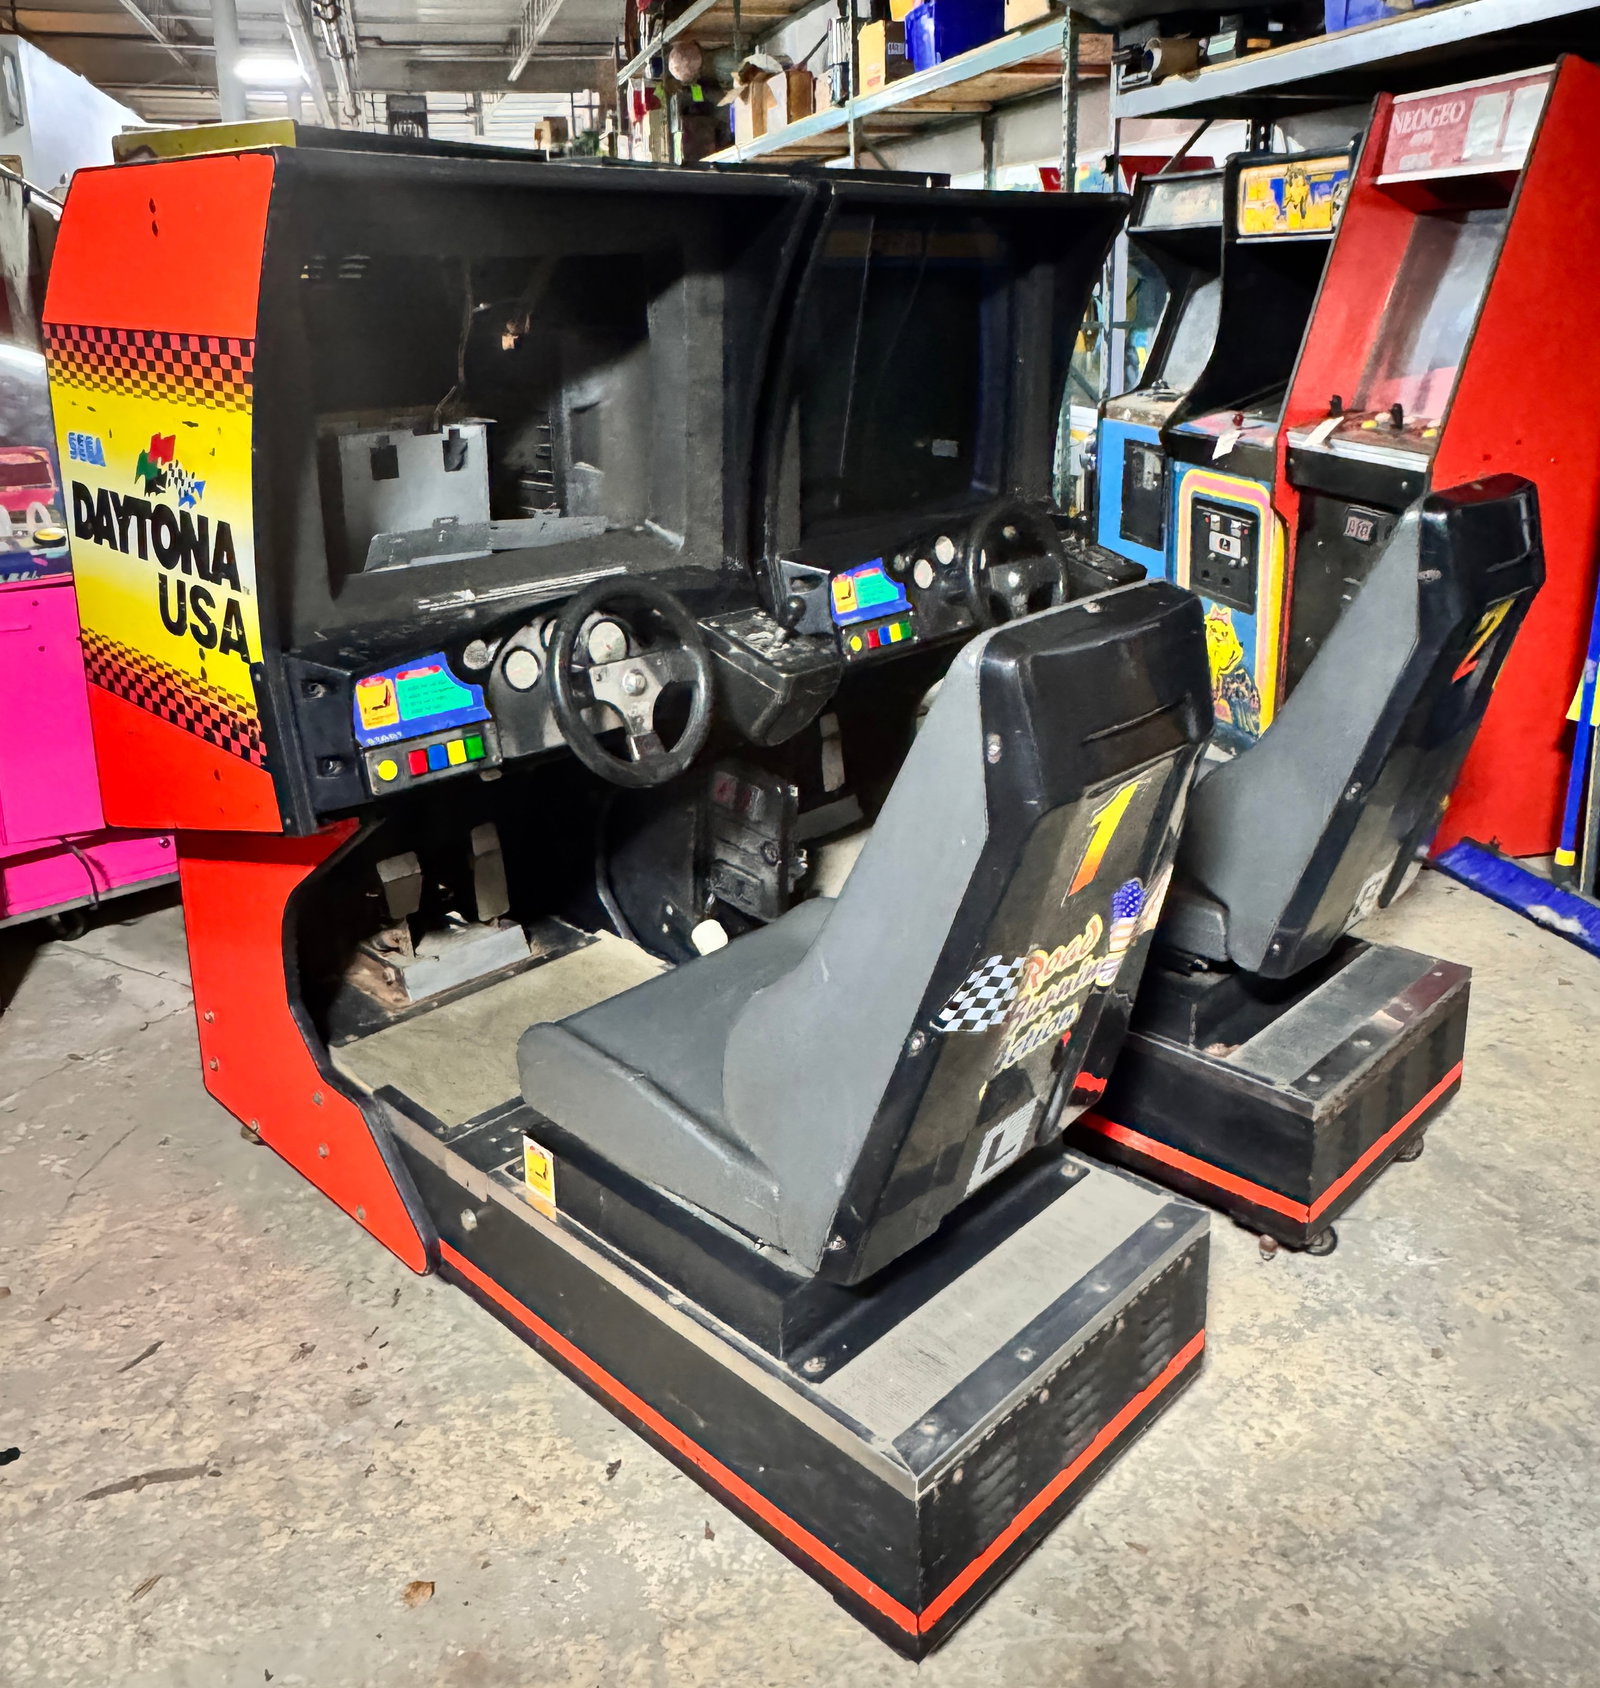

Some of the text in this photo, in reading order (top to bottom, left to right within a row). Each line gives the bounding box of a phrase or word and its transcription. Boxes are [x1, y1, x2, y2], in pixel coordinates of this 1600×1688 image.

[67, 431, 106, 468] SEGA
[72, 480, 242, 592] DAYTONA
[158, 573, 251, 664] USA
[1450, 598, 1517, 684] 2
[1065, 779, 1141, 898] 1
[1003, 953, 1125, 1027] Burning
[1025, 914, 1102, 992] Road
